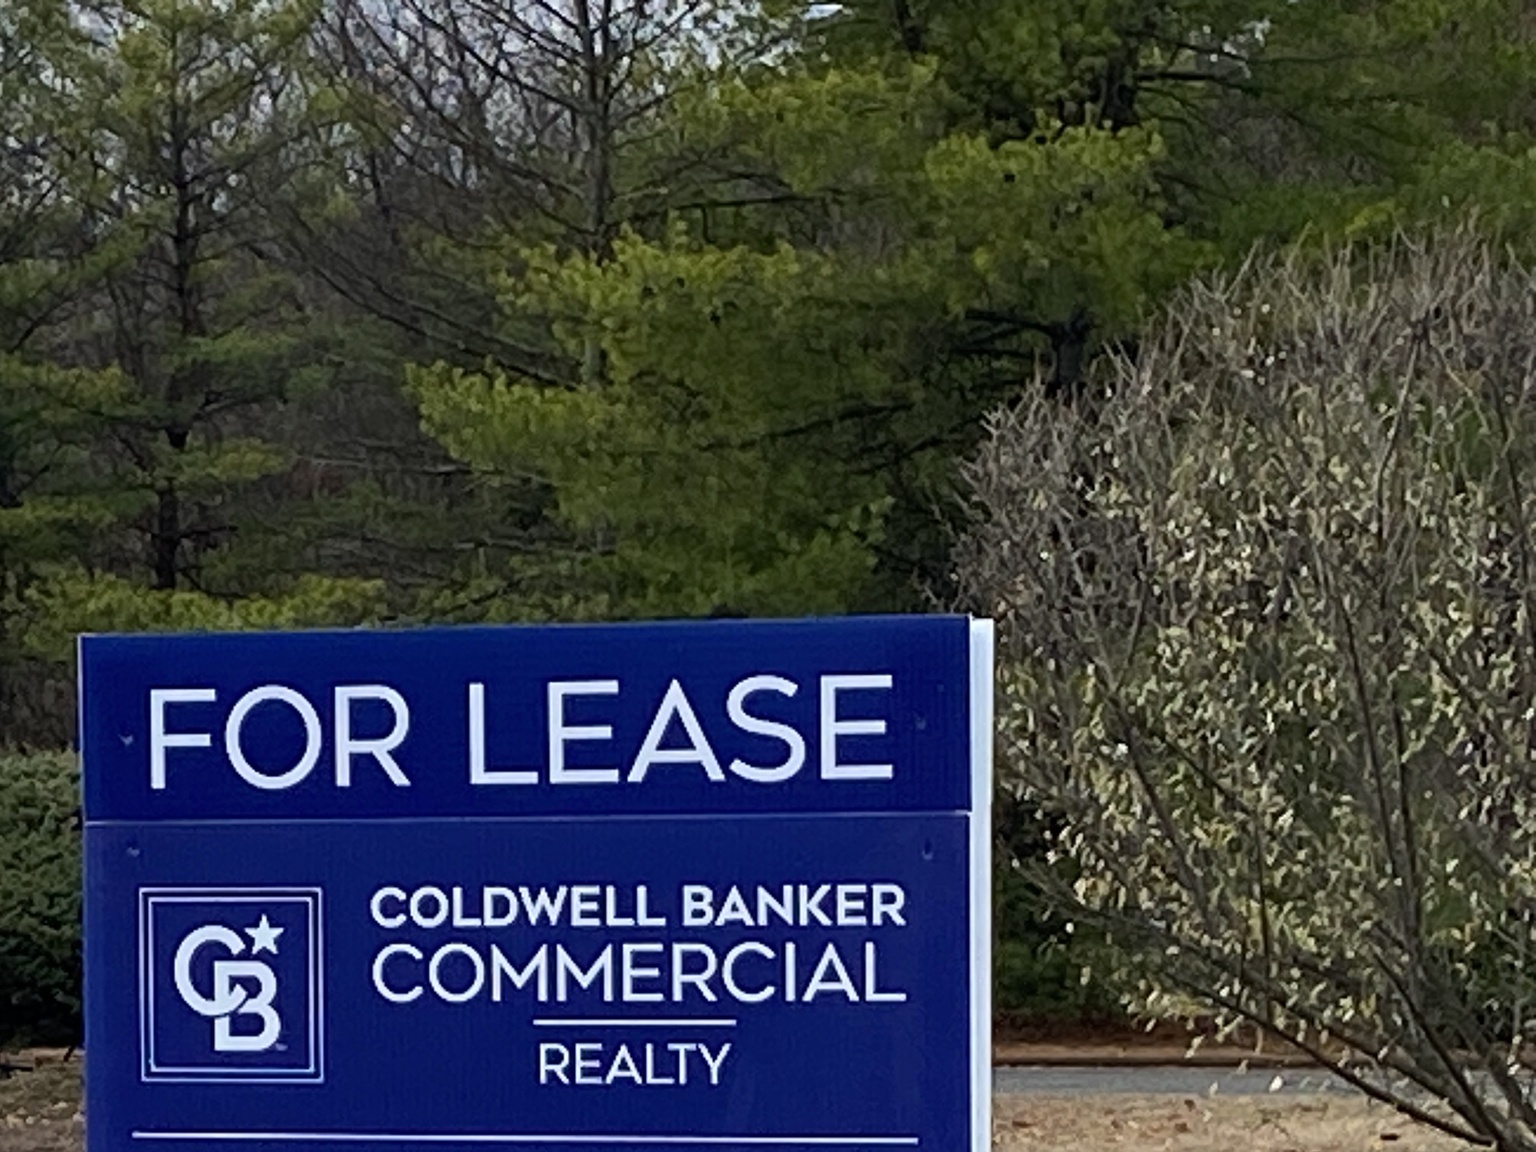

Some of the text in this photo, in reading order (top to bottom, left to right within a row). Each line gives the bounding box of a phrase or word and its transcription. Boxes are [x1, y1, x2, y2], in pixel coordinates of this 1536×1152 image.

[149, 673, 895, 790] FOR LEASE
[371, 885, 907, 928] COLDWELL BANKER
[175, 924, 282, 1052] CB
[371, 941, 908, 1003] COMMERCIAL
[537, 1042, 733, 1086] REALTY
